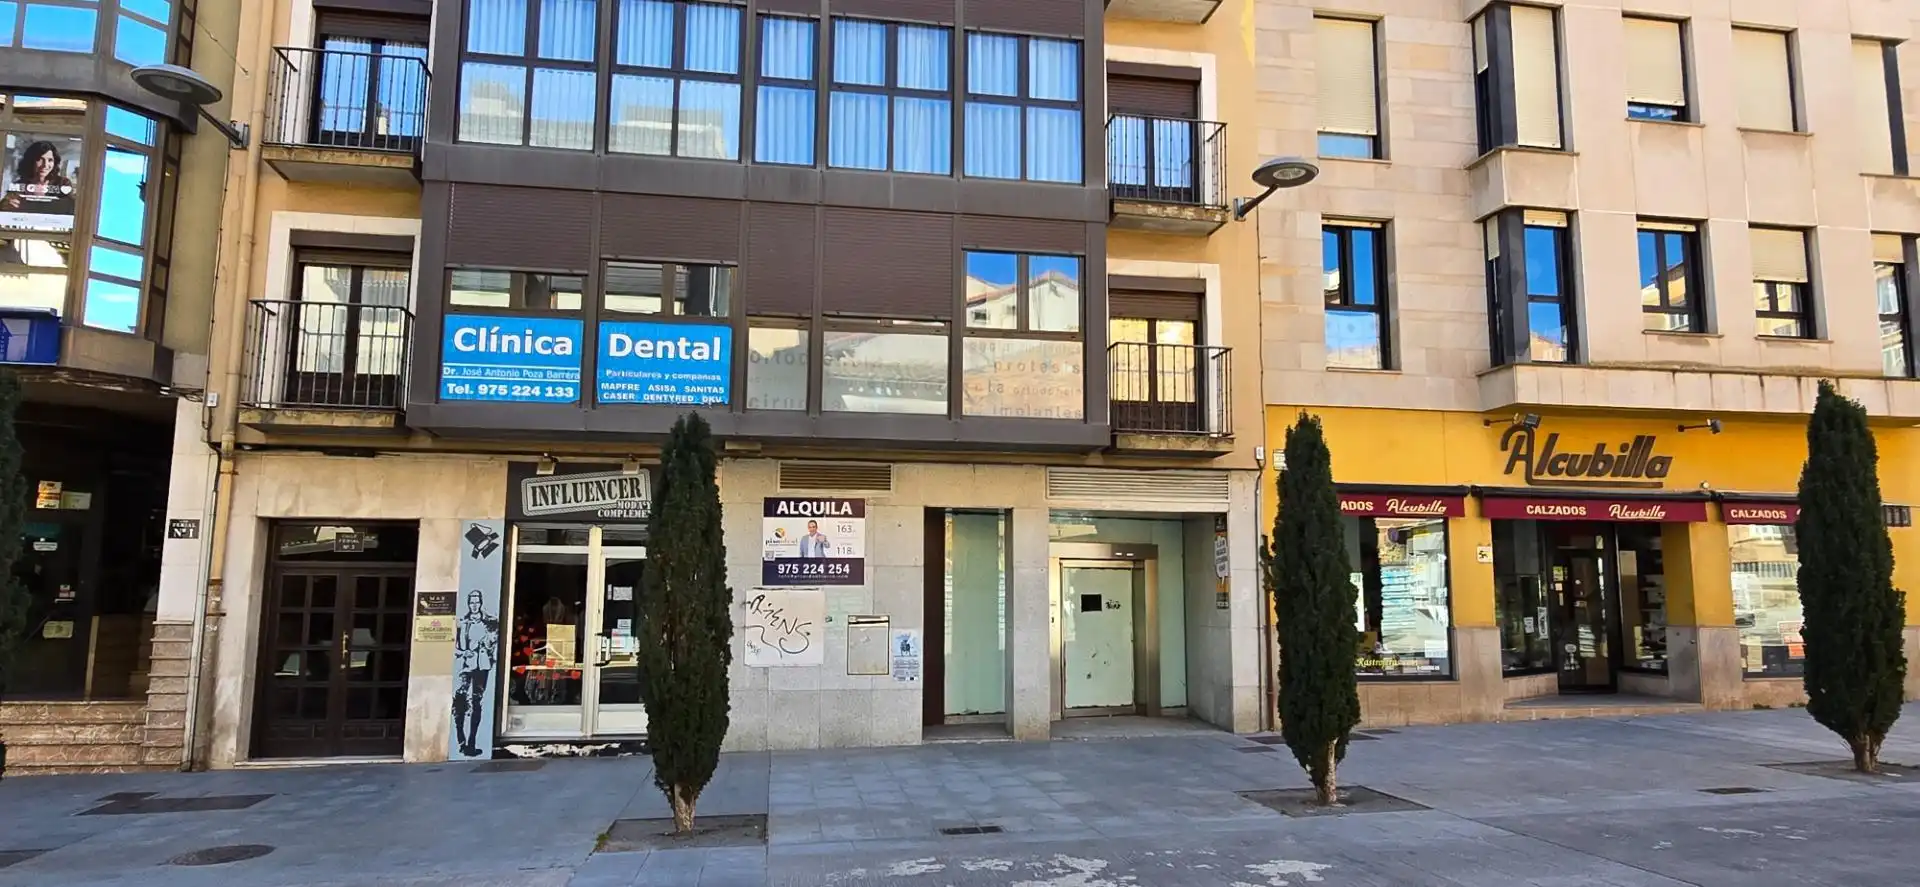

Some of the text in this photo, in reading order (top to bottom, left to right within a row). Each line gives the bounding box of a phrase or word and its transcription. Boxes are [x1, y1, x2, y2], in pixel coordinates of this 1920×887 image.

[453, 326, 573, 355] Clínica
[609, 334, 721, 361] Dental
[443, 367, 580, 380] Dr. José Antonio Poza Barrera
[606, 369, 662, 379] Particulares
[447, 383, 574, 398] Tel. 975 224 133
[601, 383, 725, 394] MAPFRE ASISA SANITAS
[603, 392, 635, 400] CASER
[1501, 424, 1673, 487] Alcubilla
[531, 477, 642, 507] INFLUENCER
[617, 501, 643, 510] MODA
[776, 501, 853, 516] ALQUILA
[1338, 499, 1447, 515] ADOS Alcubilla
[1526, 504, 1666, 519] CALZADOS Alcubilla
[597, 509, 652, 518] COMPLEME
[1730, 508, 1788, 519] CALZADOS
[836, 524, 853, 533] 163
[777, 564, 850, 574] 975 224 254
